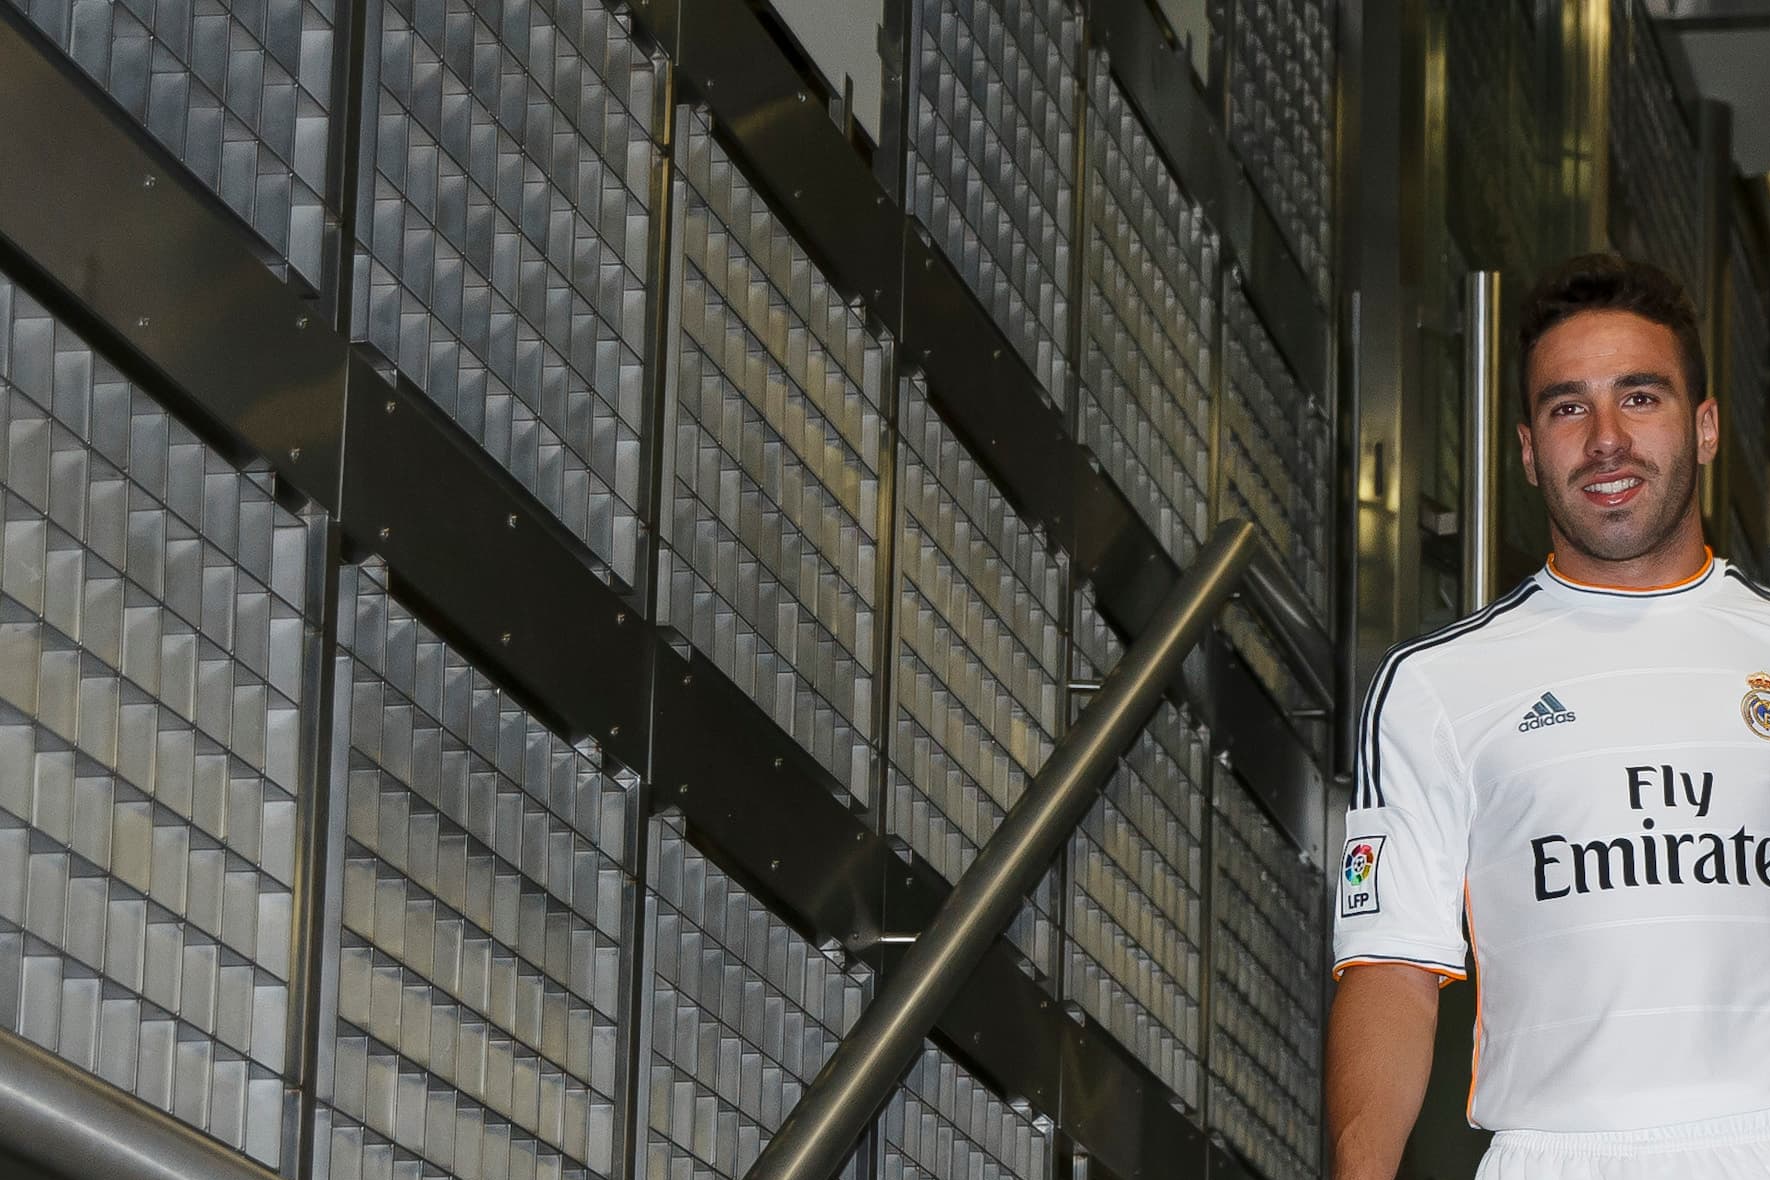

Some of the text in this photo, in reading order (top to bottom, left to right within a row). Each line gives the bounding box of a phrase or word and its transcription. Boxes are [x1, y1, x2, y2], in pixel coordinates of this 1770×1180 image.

[1518, 711, 1576, 732] adidas
[1625, 765, 1713, 817] Fly
[1347, 892, 1369, 909] LFP
